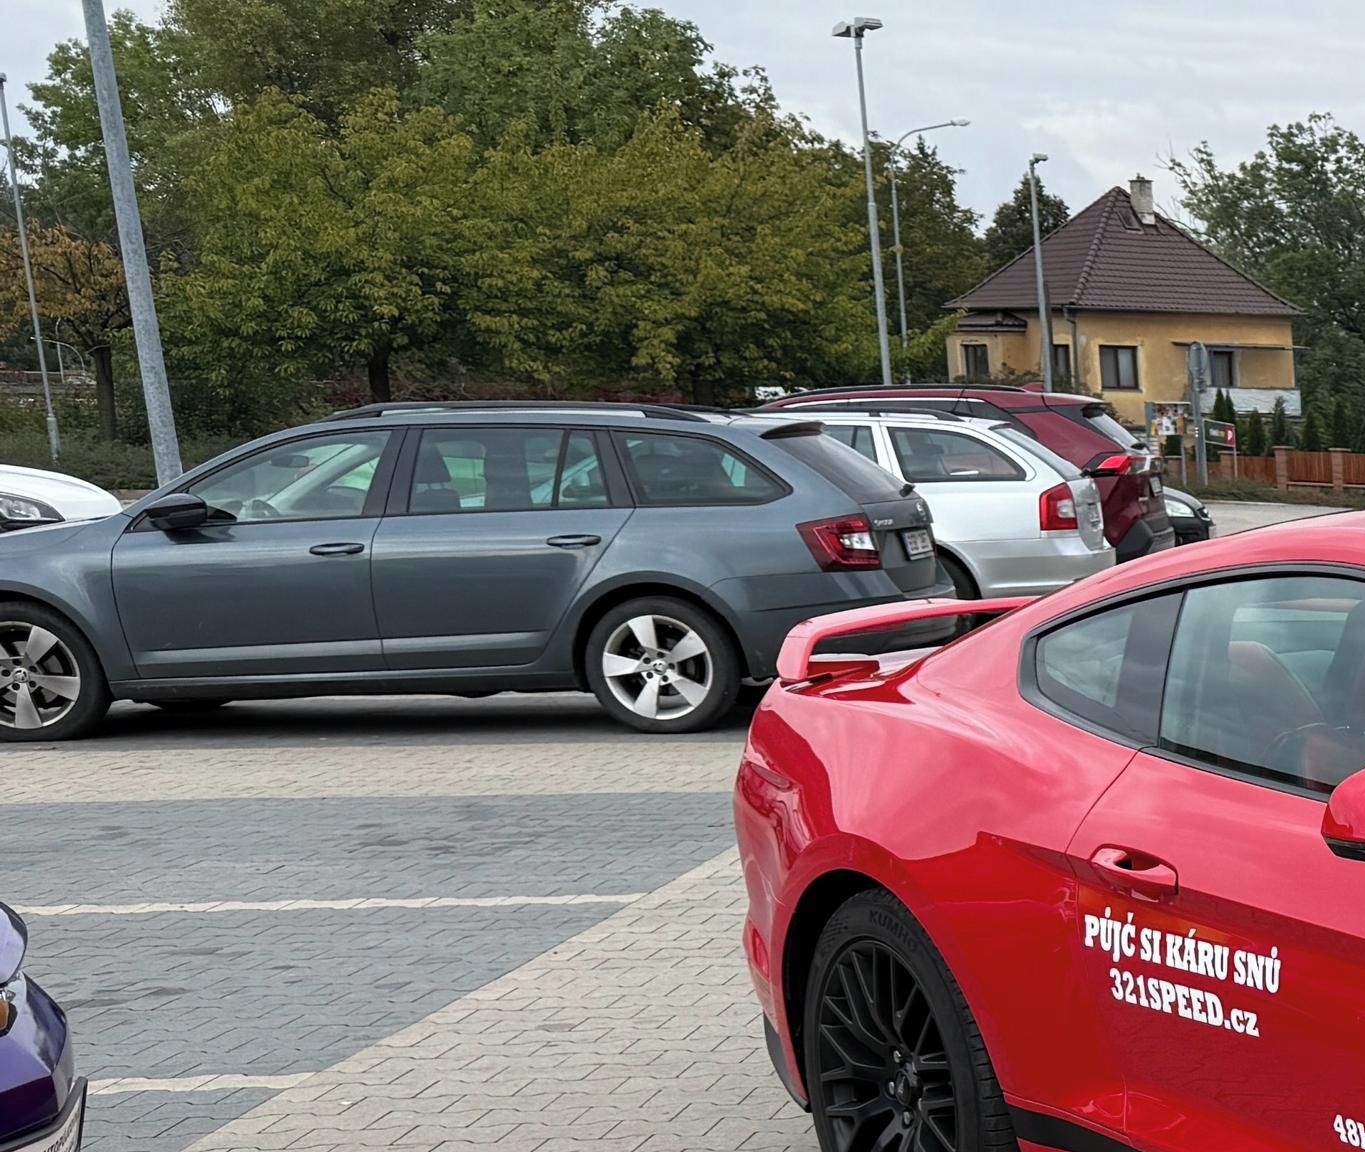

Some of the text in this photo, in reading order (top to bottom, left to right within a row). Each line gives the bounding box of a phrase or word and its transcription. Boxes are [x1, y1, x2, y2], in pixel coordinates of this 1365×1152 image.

[869, 909, 919, 953] KUMHO
[1139, 927, 1162, 965] SI
[1165, 928, 1230, 981] KÁRU
[1109, 967, 1260, 1038] 321SPEED.cz
